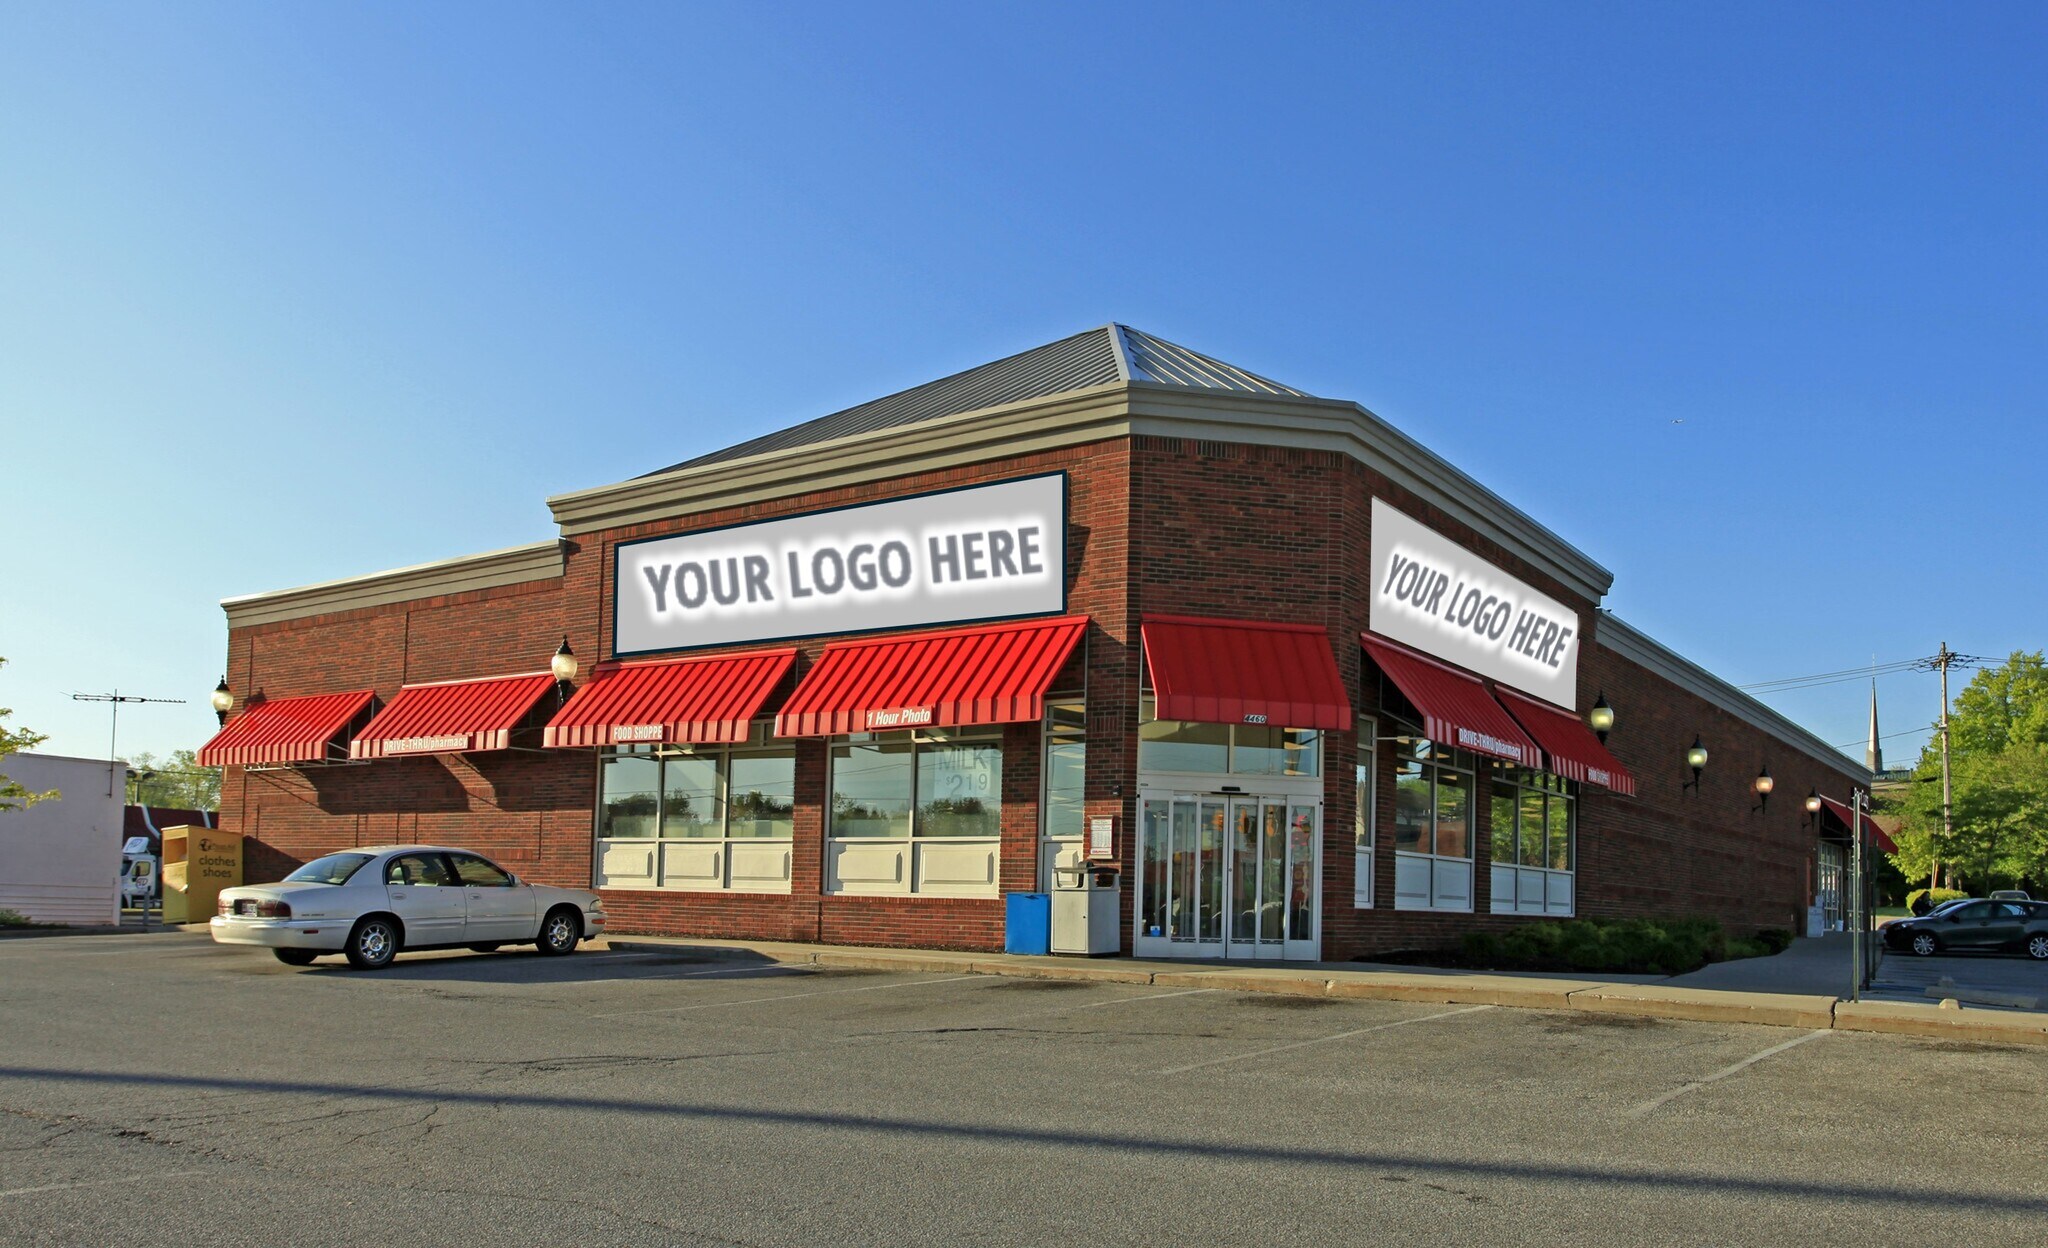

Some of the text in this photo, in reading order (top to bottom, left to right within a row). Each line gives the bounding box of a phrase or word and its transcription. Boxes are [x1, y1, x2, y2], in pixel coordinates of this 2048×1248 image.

[643, 526, 1043, 612] YOUR LOGO HERE
[1383, 553, 1573, 668] YOUR LOGO HERE
[867, 708, 930, 726] 1 Hour Photo
[1244, 714, 1266, 723] 4460
[614, 725, 662, 740] FOOD SHOPPE
[937, 746, 988, 770] MILK
[199, 855, 236, 867] clothes
[203, 867, 232, 877] shoes
